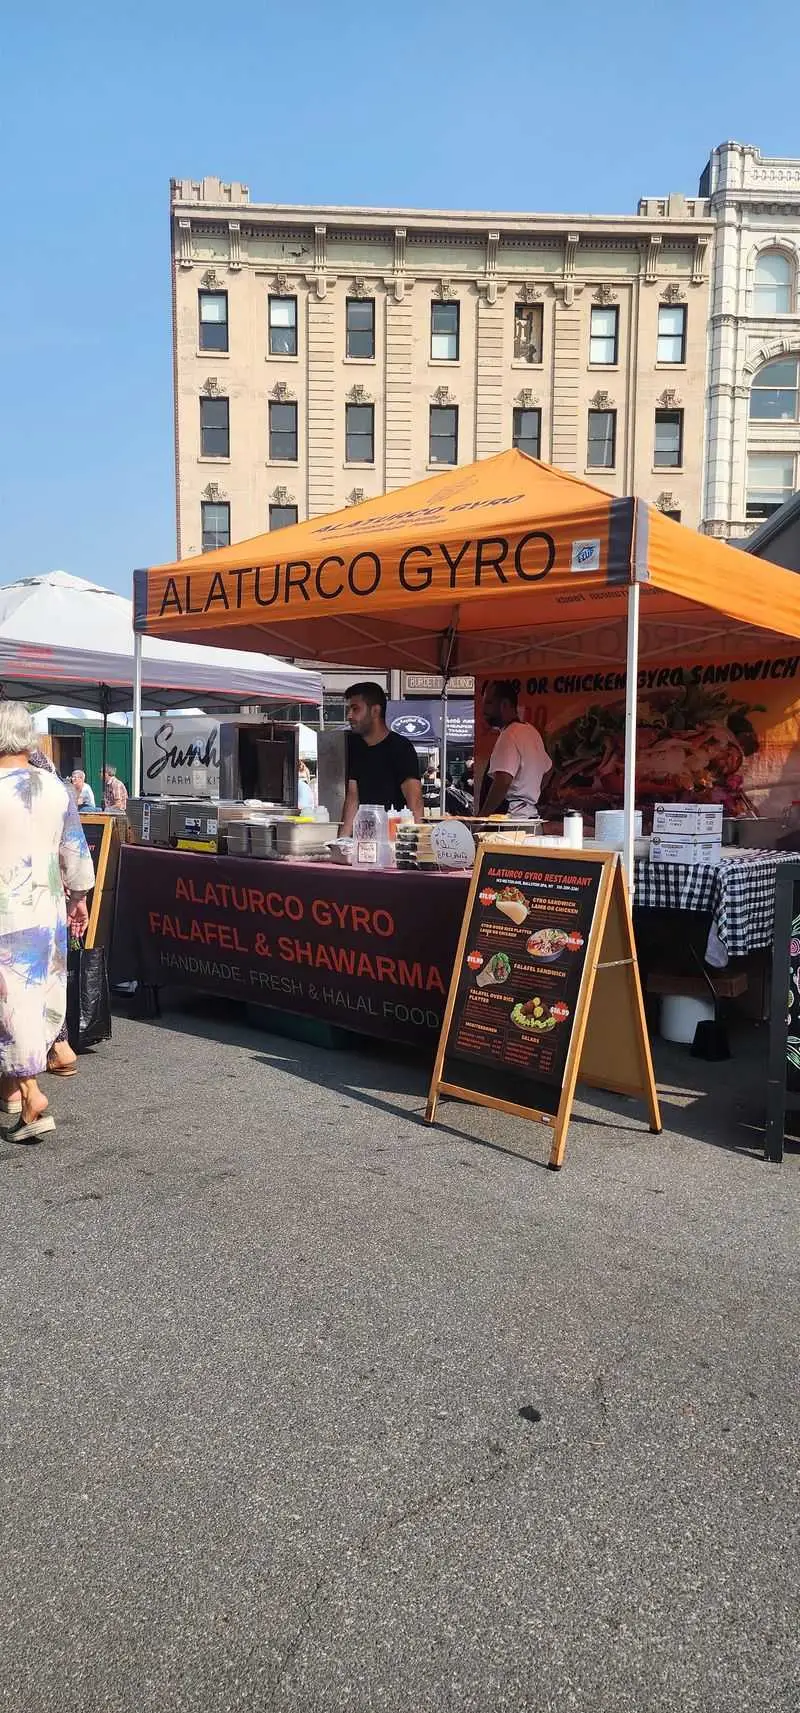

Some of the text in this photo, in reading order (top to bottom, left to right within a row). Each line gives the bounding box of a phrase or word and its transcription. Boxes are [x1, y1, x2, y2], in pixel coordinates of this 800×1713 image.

[311, 506, 445, 534] ALATURCO
[449, 494, 526, 512] GYRO
[159, 530, 556, 616] ALATURCO GYRO
[527, 677, 549, 697] OR
[167, 775, 191, 785] FARM
[487, 867, 593, 887] ALATURCO GYRO RESTAURANT
[175, 877, 394, 937] ALATURCO GYRO
[547, 898, 576, 907] SANDWICH
[555, 906, 579, 914] CHICKEN
[149, 912, 249, 952] FALAFEL
[255, 932, 272, 958] &
[279, 936, 447, 995] SHAWARMA
[513, 963, 567, 978] FALAFEL SANDWICH
[250, 969, 303, 996] FRESH
[308, 984, 321, 1000] &
[323, 989, 378, 1016] HALAL
[383, 1000, 440, 1029] FOOD
